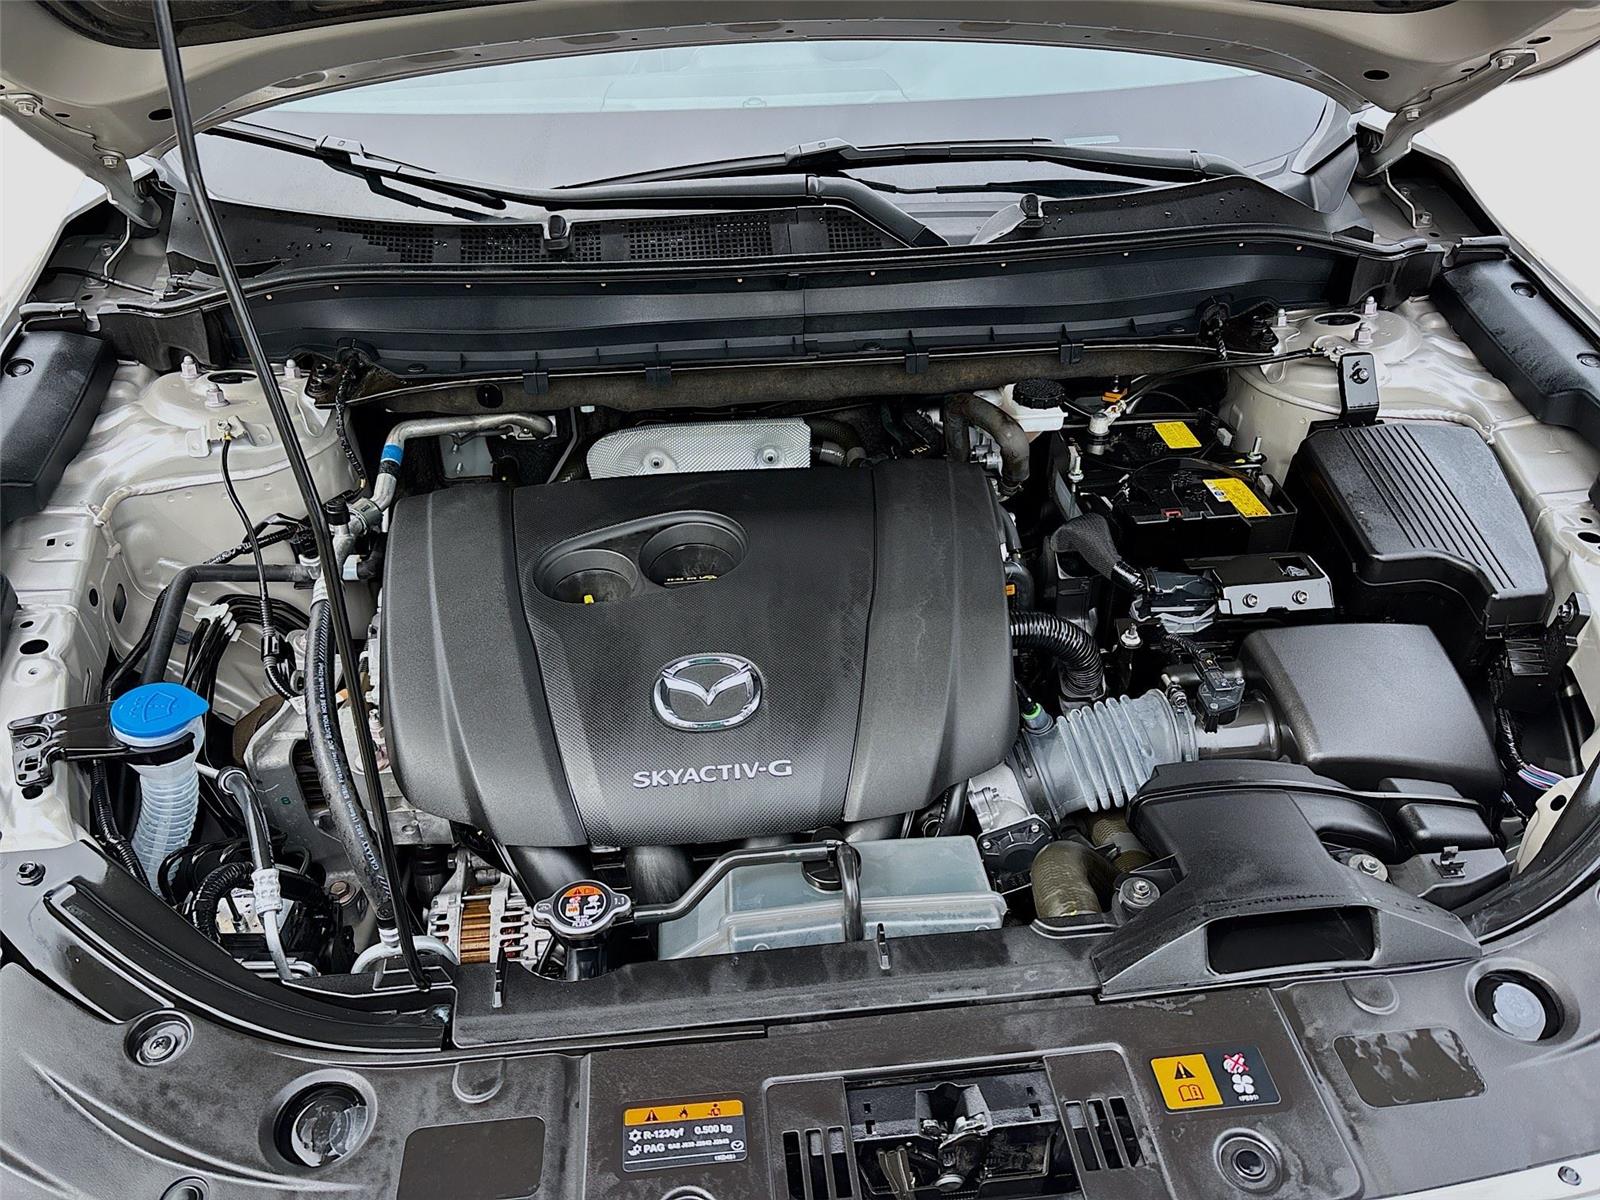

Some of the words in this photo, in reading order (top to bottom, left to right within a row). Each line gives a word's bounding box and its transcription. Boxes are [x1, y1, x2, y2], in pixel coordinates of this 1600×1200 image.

[319, 699, 328, 714] HOSE
[322, 715, 332, 739] SUCTION
[632, 759, 793, 789] SKYACTIV-G
[361, 840, 380, 871] GALAXY
[643, 1127, 685, 1140] R-1234yf
[694, 1124, 719, 1135] 0.500
[720, 1123, 733, 1134] kg
[643, 1143, 665, 1154] PAG
